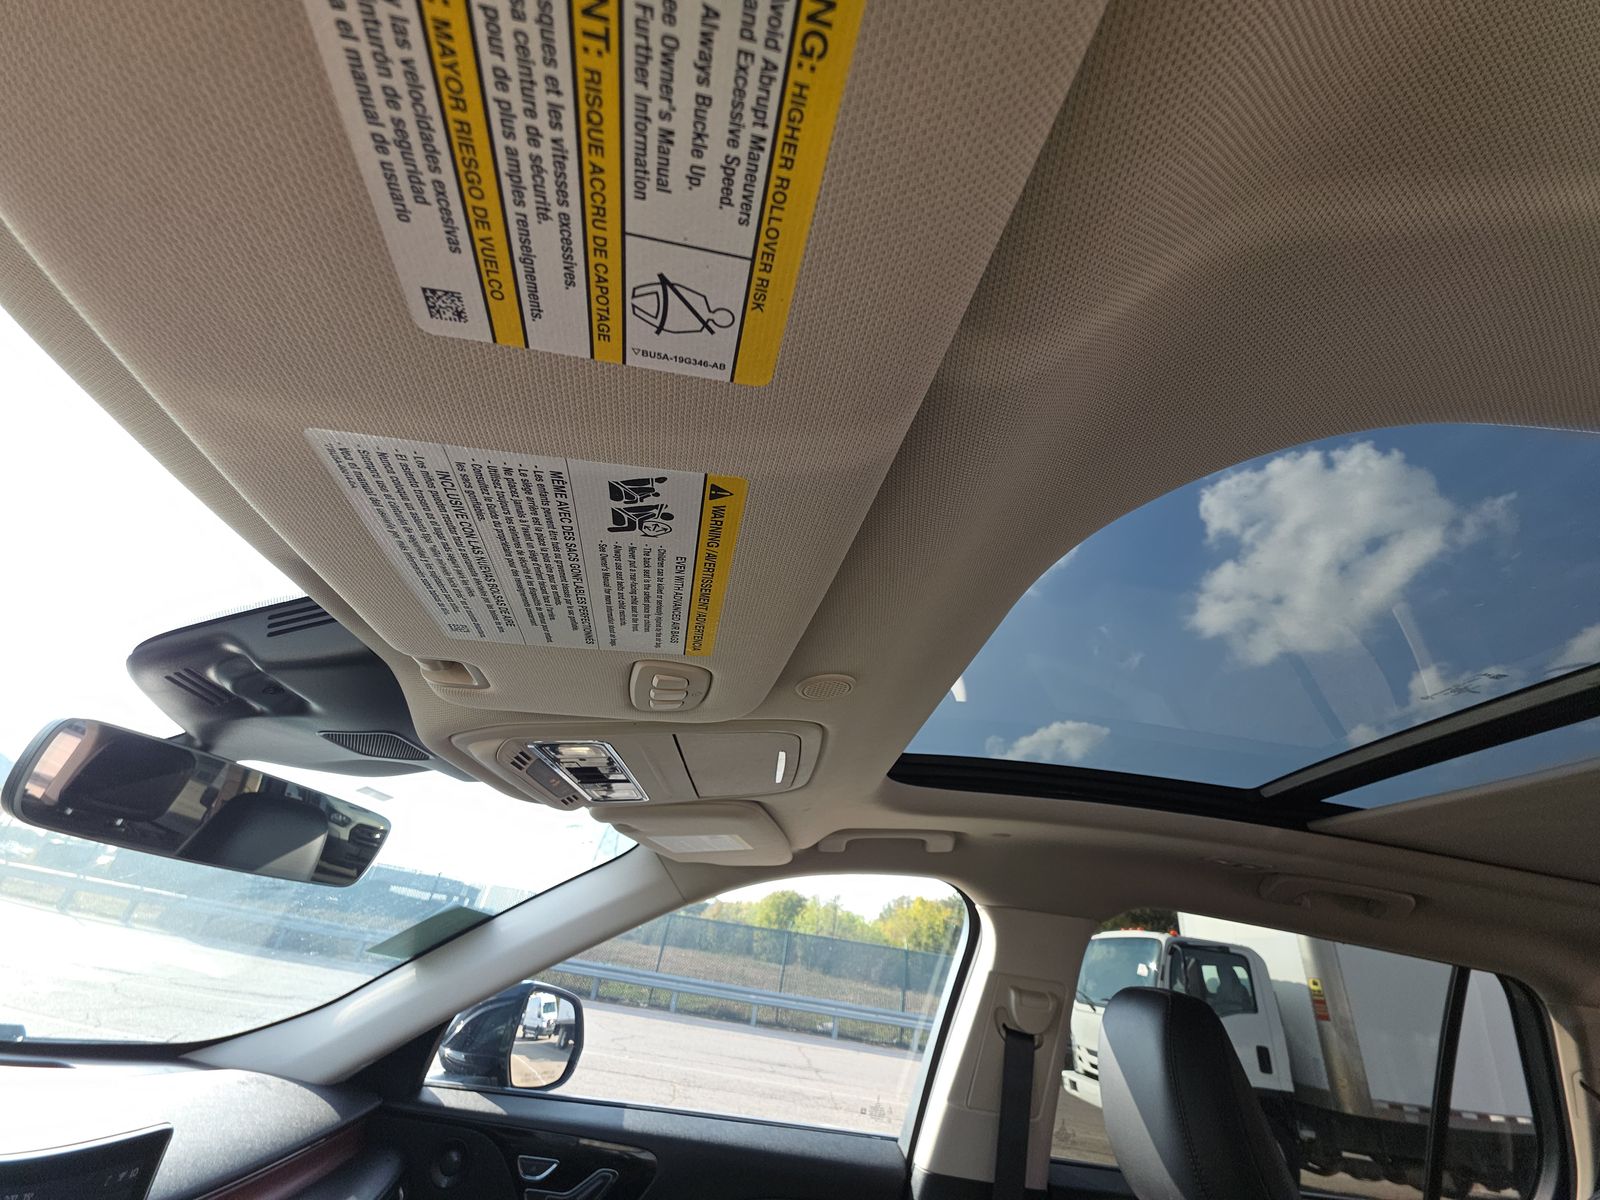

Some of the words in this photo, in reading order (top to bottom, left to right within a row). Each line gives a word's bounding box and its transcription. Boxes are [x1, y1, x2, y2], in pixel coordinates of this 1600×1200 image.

[334, 18, 360, 42] el
[388, 13, 412, 50] las
[477, 3, 505, 62] pour
[634, 1, 655, 90] Further
[693, 2, 721, 87] Always
[763, 0, 789, 53] void
[431, 16, 468, 113] MAYOR
[491, 65, 512, 93] de
[512, 29, 538, 120] ceinture
[543, 74, 564, 97] et
[658, 33, 680, 122] Owner's
[343, 47, 386, 128] manual
[380, 84, 403, 111] de
[726, 47, 755, 149] Excessive
[750, 56, 779, 129] Abrupt
[399, 57, 442, 174] velocidades
[492, 96, 517, 141] plus
[546, 101, 565, 132] les
[583, 67, 604, 158] RISQUE
[690, 92, 713, 159] Buckle
[778, 81, 810, 171] HIGHER
[369, 131, 391, 156] de
[524, 124, 544, 149] de
[633, 93, 652, 201] Information
[389, 115, 432, 206] seguridad
[452, 118, 485, 201] RIESGO
[503, 145, 527, 208] amples
[550, 137, 570, 208] vitesses
[655, 127, 675, 194] Manual
[685, 164, 706, 191] Up.
[718, 153, 741, 210] Speed.
[737, 133, 767, 227] Maneuvers
[379, 159, 412, 223] usuario
[528, 152, 553, 225] sécurité.
[588, 160, 607, 231] ACCRU
[430, 178, 462, 254] excesivas
[471, 204, 491, 231] DE
[758, 175, 791, 274] ROLLOVER
[478, 236, 505, 301] VUELCO
[514, 211, 544, 322] renseignements.
[557, 211, 578, 290] excessives.
[592, 234, 608, 259] DE
[593, 262, 611, 343] CAPOTAGE
[750, 276, 770, 313] RISK
[486, 465, 503, 490] Utilisez
[502, 466, 514, 476] Ne
[502, 477, 520, 498] placez
[517, 468, 529, 477] Le
[532, 470, 544, 482] Les
[549, 470, 568, 499] MÊME
[435, 470, 469, 520] INCLUSIVE
[536, 483, 551, 506] enfants
[555, 499, 572, 524] AVEC
[458, 521, 478, 539] CON
[467, 540, 484, 555] LAS
[561, 525, 576, 541] DES
[598, 543, 608, 553] See
[706, 505, 726, 548] WARNING
[564, 542, 580, 562] SACS
[642, 547, 652, 557] The
[674, 556, 687, 575] EVEN
[569, 563, 587, 605] GONFLABLES
[673, 575, 685, 591] WITH
[671, 590, 683, 621] ADVANCED
[671, 620, 680, 630] AIR
[670, 630, 680, 644] BAGS
